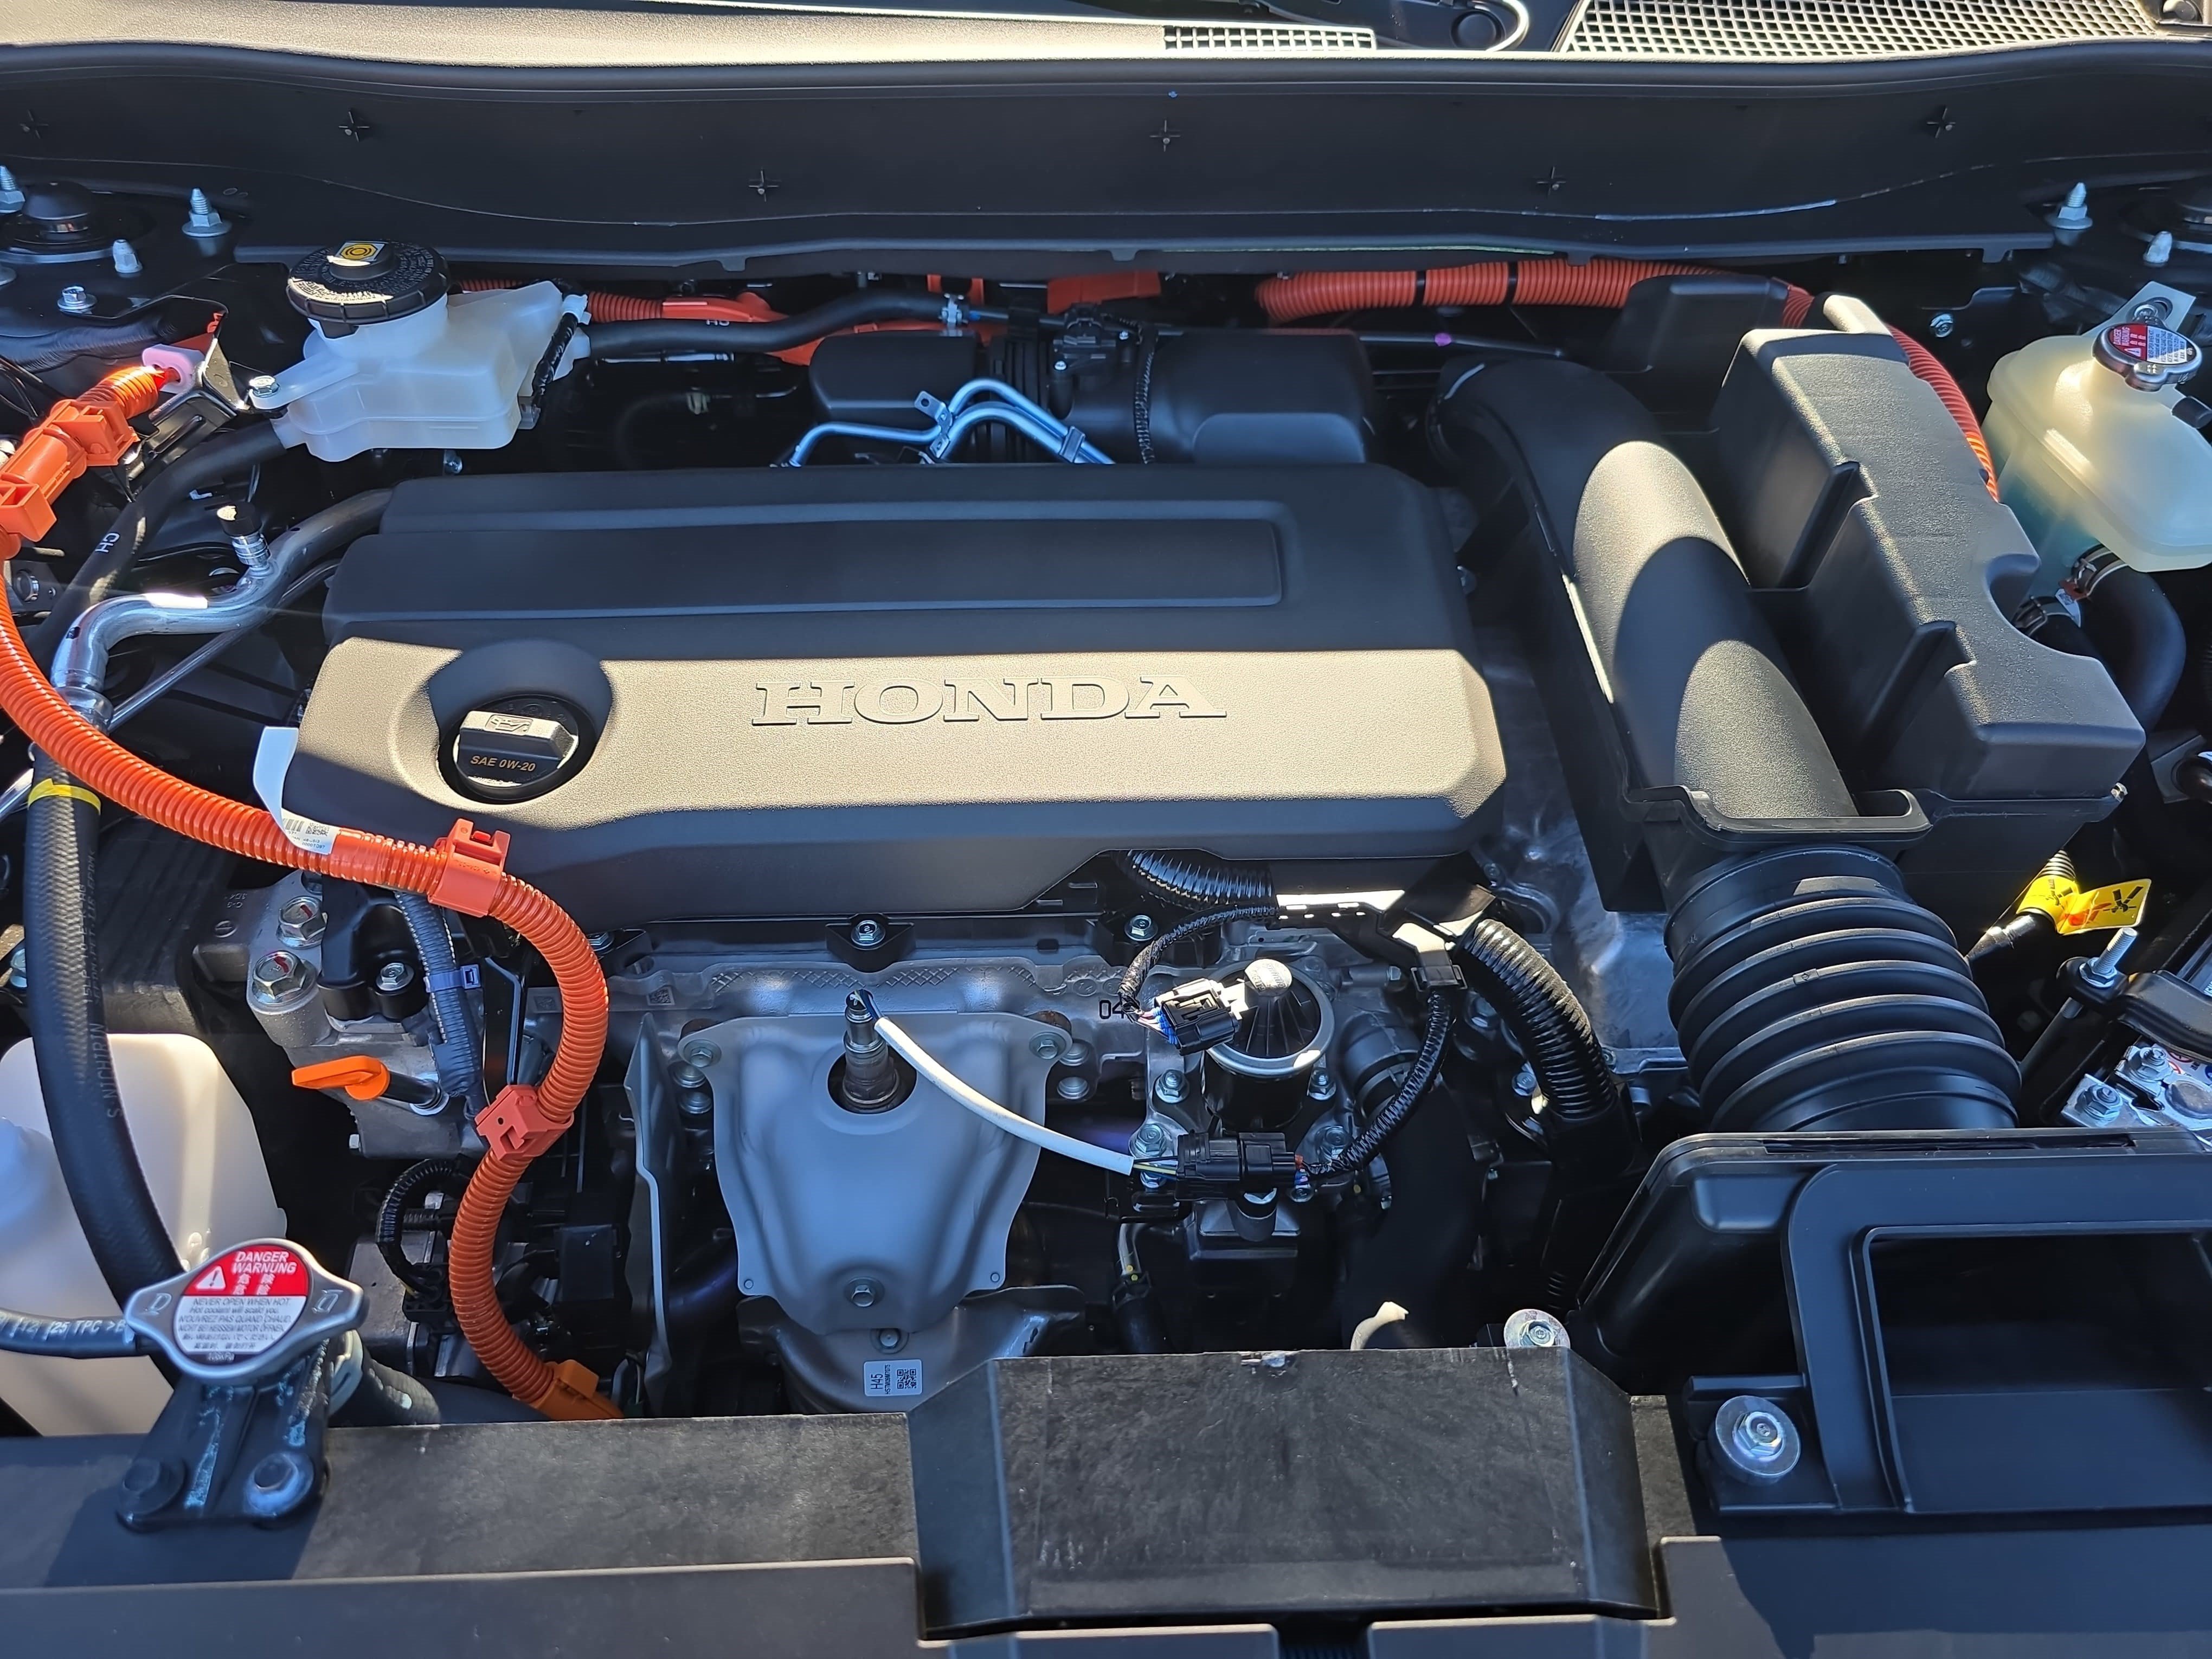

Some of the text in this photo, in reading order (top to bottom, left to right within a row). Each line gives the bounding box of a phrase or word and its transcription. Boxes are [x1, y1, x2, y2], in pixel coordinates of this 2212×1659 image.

[751, 675, 1227, 726] HONDA
[470, 755, 536, 771] SAE 0W-20
[235, 1251, 289, 1262] DANGER
[232, 1262, 297, 1274] WARNUNG
[870, 1373, 884, 1390] H45
